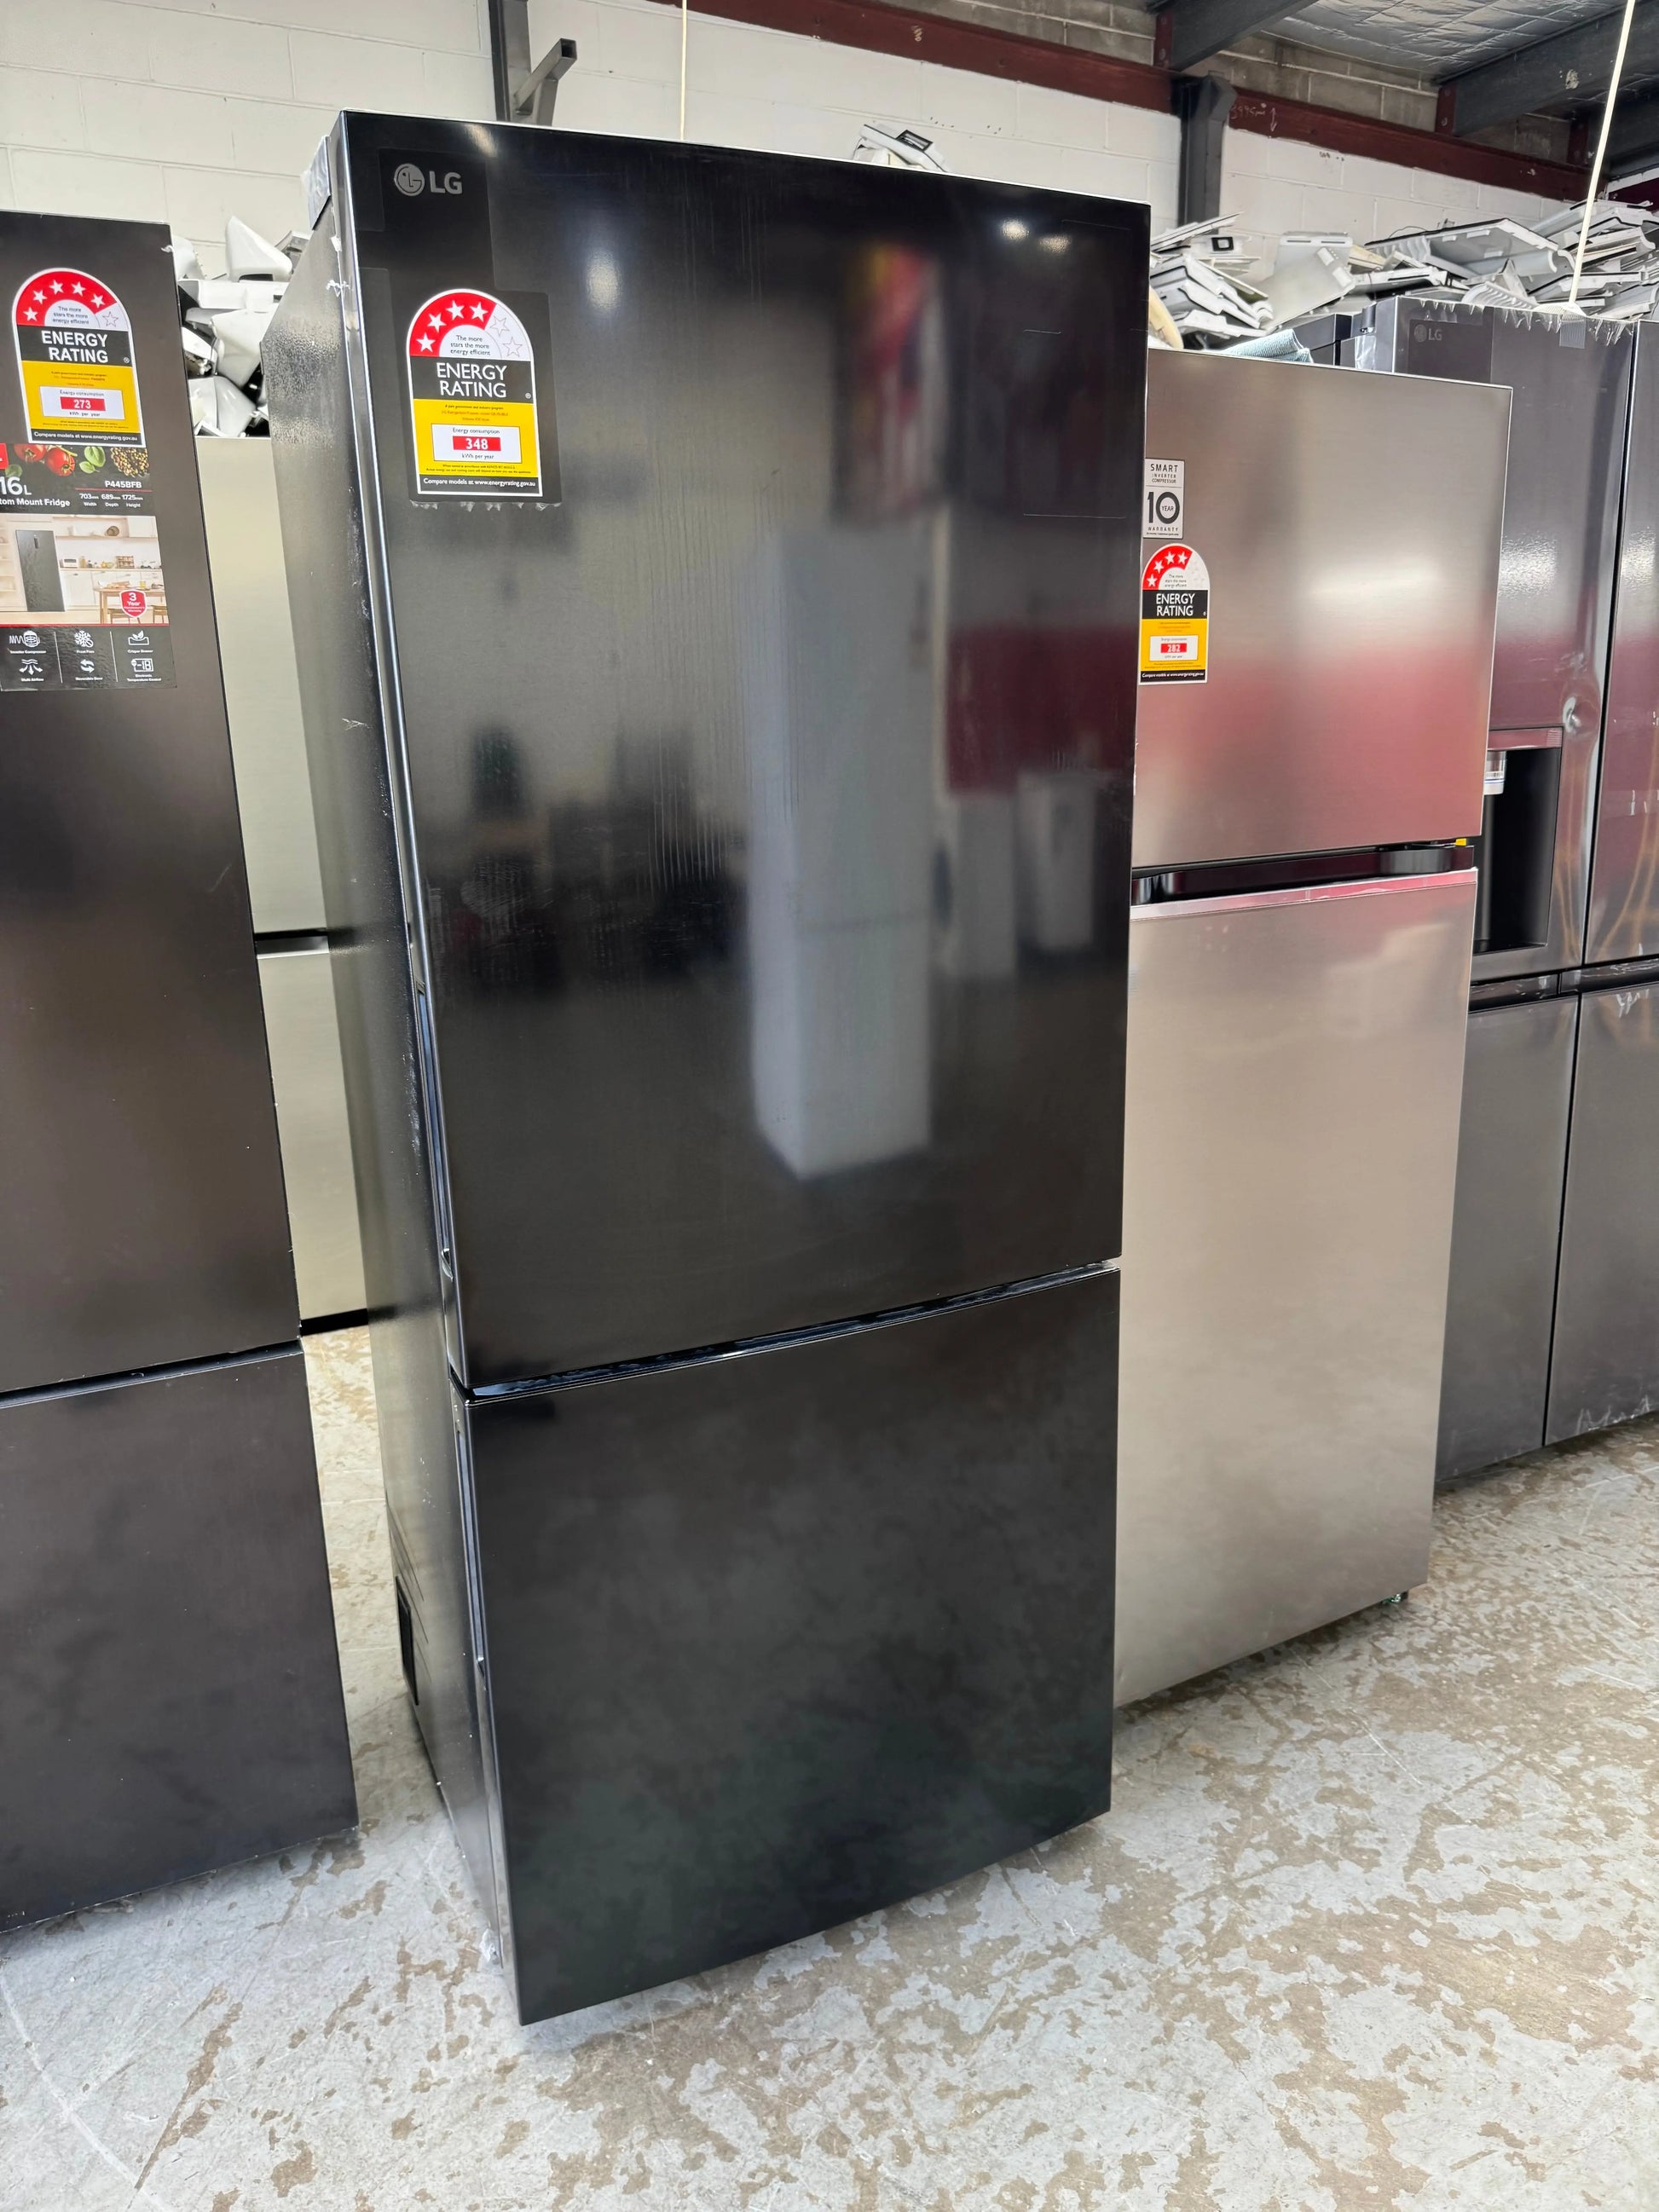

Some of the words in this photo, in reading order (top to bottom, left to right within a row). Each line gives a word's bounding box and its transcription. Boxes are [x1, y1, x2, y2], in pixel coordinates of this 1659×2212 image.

[429, 170, 463, 195] LG
[41, 330, 107, 347] ENERGY
[1428, 327, 1442, 341] LG
[48, 346, 108, 363] RATING
[436, 362, 507, 380] ENERGY
[439, 380, 506, 398] RATING
[73, 399, 91, 409] 273
[465, 437, 488, 450] 348
[1150, 463, 1178, 472] SMART
[423, 477, 448, 486] Compare
[44, 498, 71, 507] Fridge
[1147, 491, 1180, 524] 10
[129, 592, 136, 601] 3
[1155, 592, 1195, 604] ENERGY
[1156, 605, 1194, 616] RATING
[1167, 644, 1181, 653] 282
